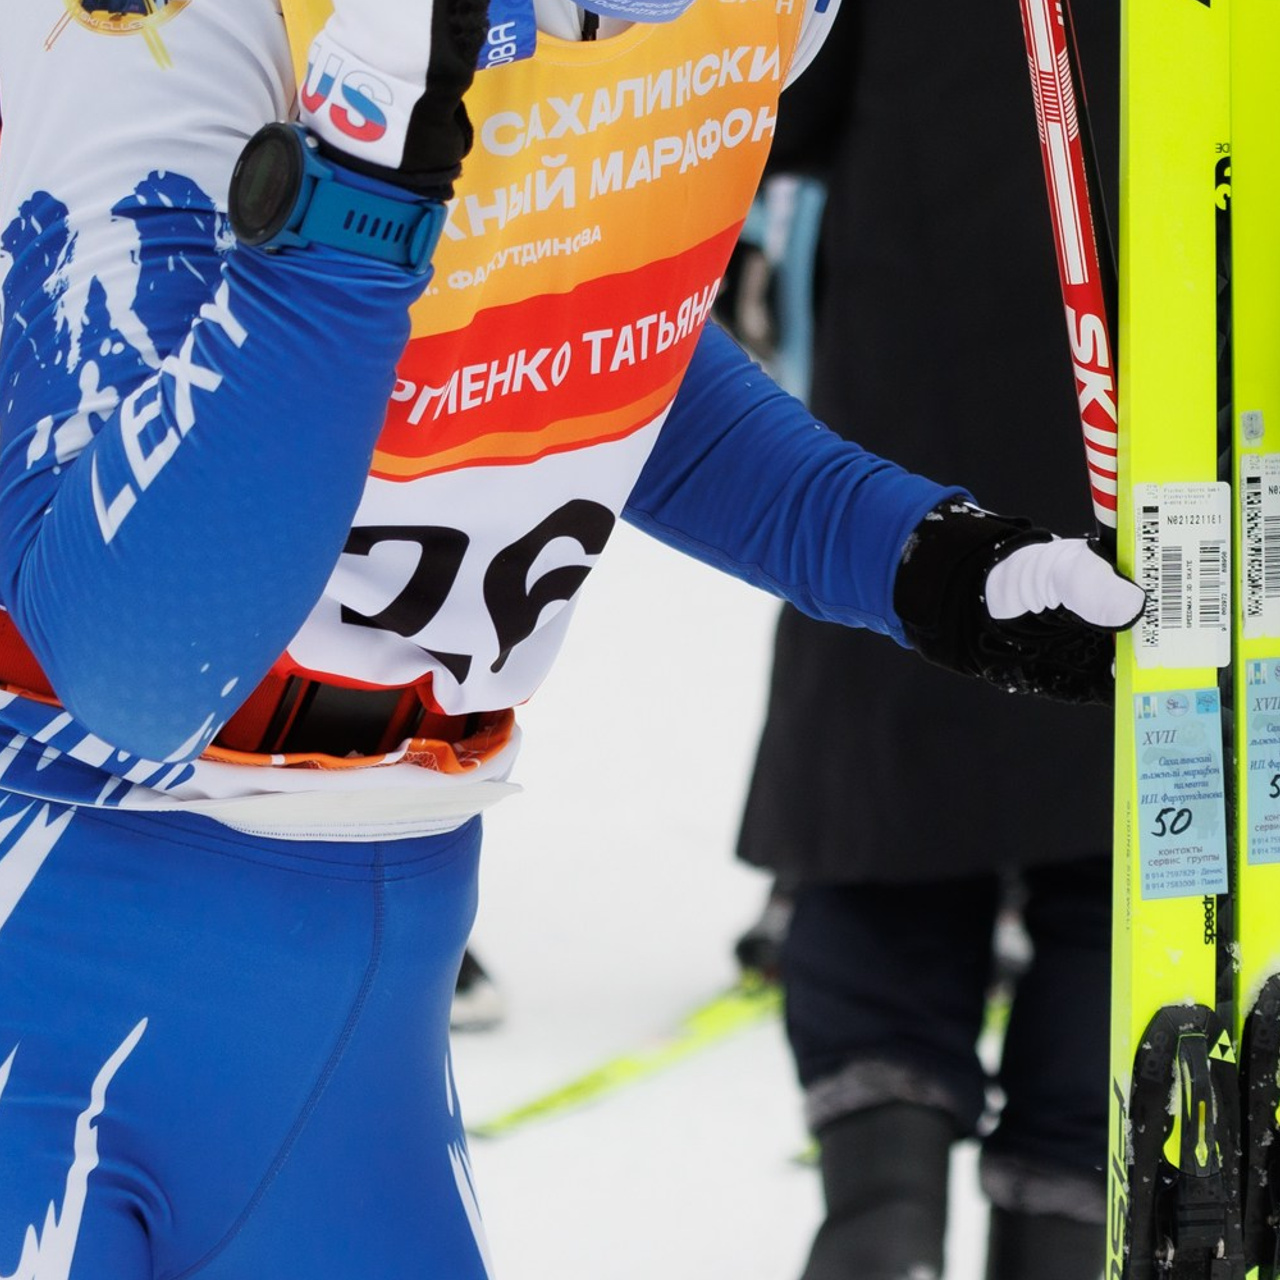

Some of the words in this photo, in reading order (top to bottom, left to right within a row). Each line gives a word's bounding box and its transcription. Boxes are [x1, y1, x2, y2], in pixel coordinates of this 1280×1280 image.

[589, 106, 777, 199] МАРАФОН
[582, 277, 721, 375] ТАТЬЯНА
[1142, 729, 1177, 746] XVII
[1151, 807, 1193, 837] 50
